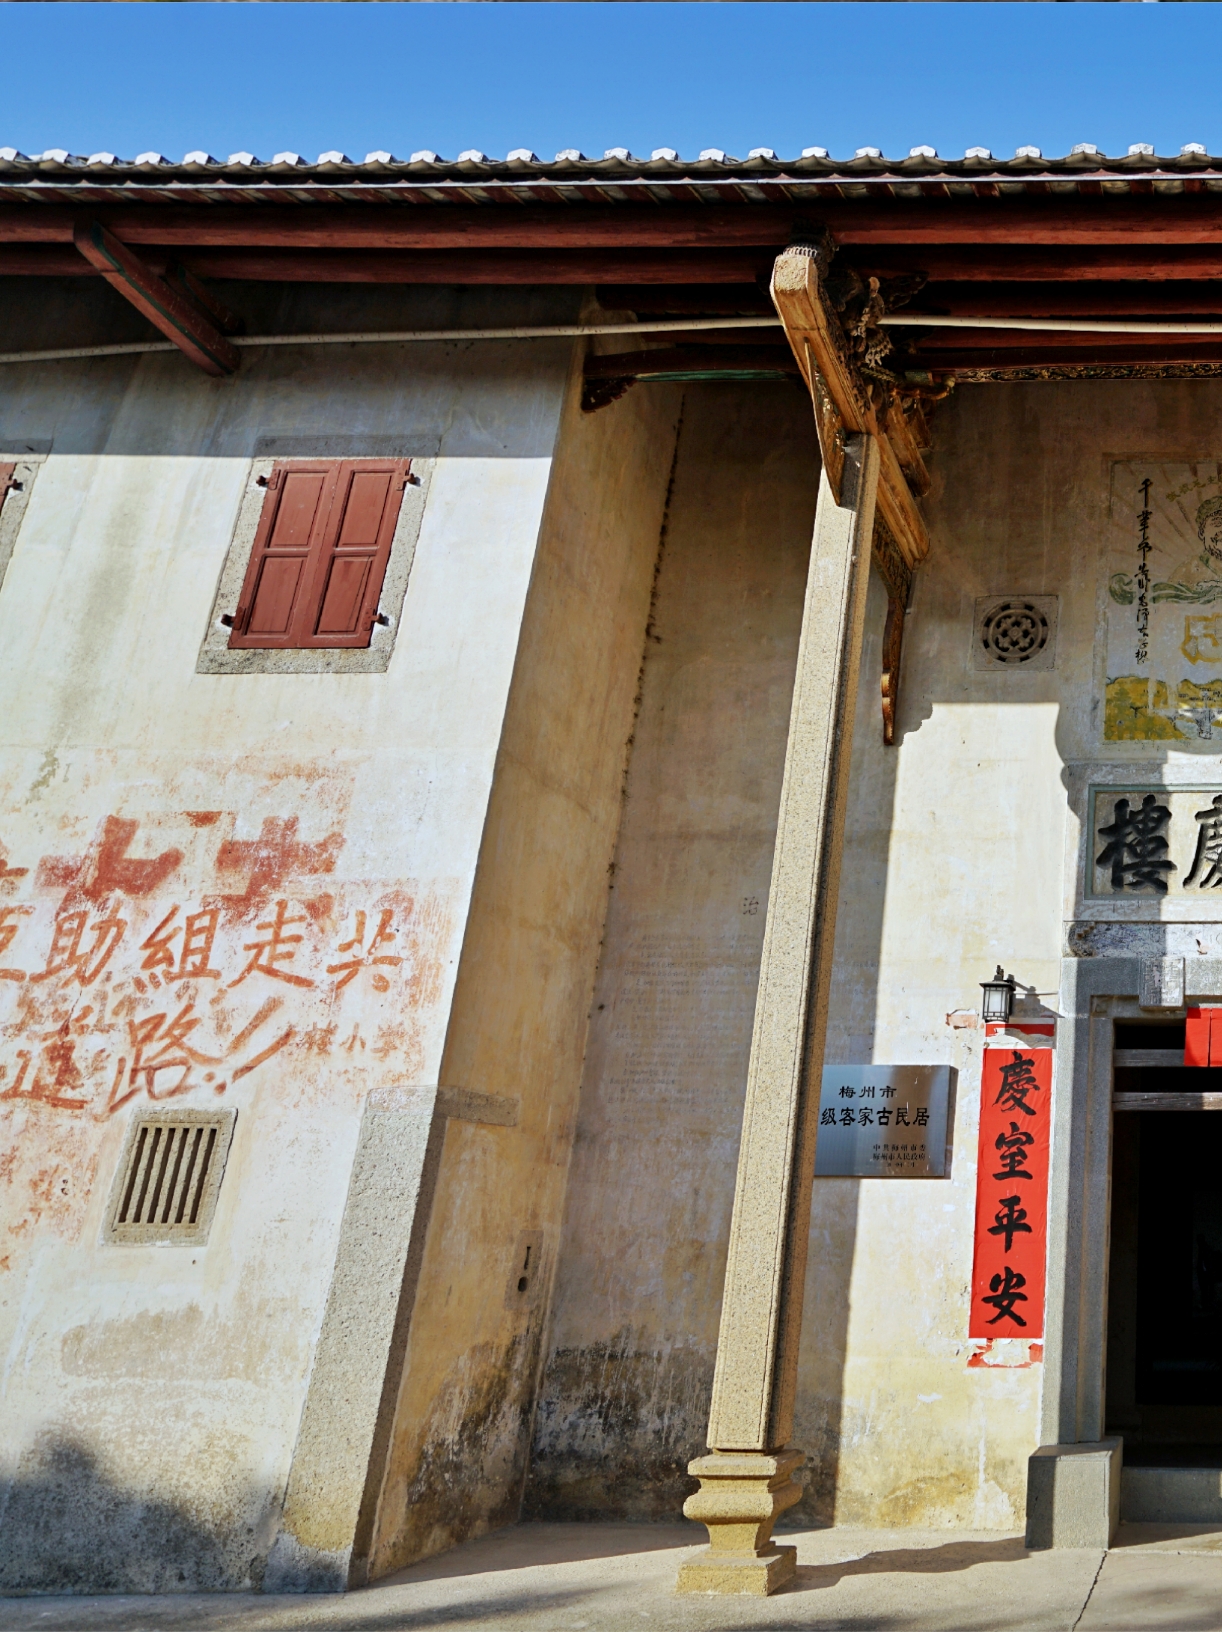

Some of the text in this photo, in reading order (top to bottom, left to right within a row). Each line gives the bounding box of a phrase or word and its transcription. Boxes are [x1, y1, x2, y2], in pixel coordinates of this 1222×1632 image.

[838, 1085, 897, 1099] 梅州市
[820, 1107, 930, 1127] 级客家古民居
[981, 1050, 1040, 1327] 慶室平安
